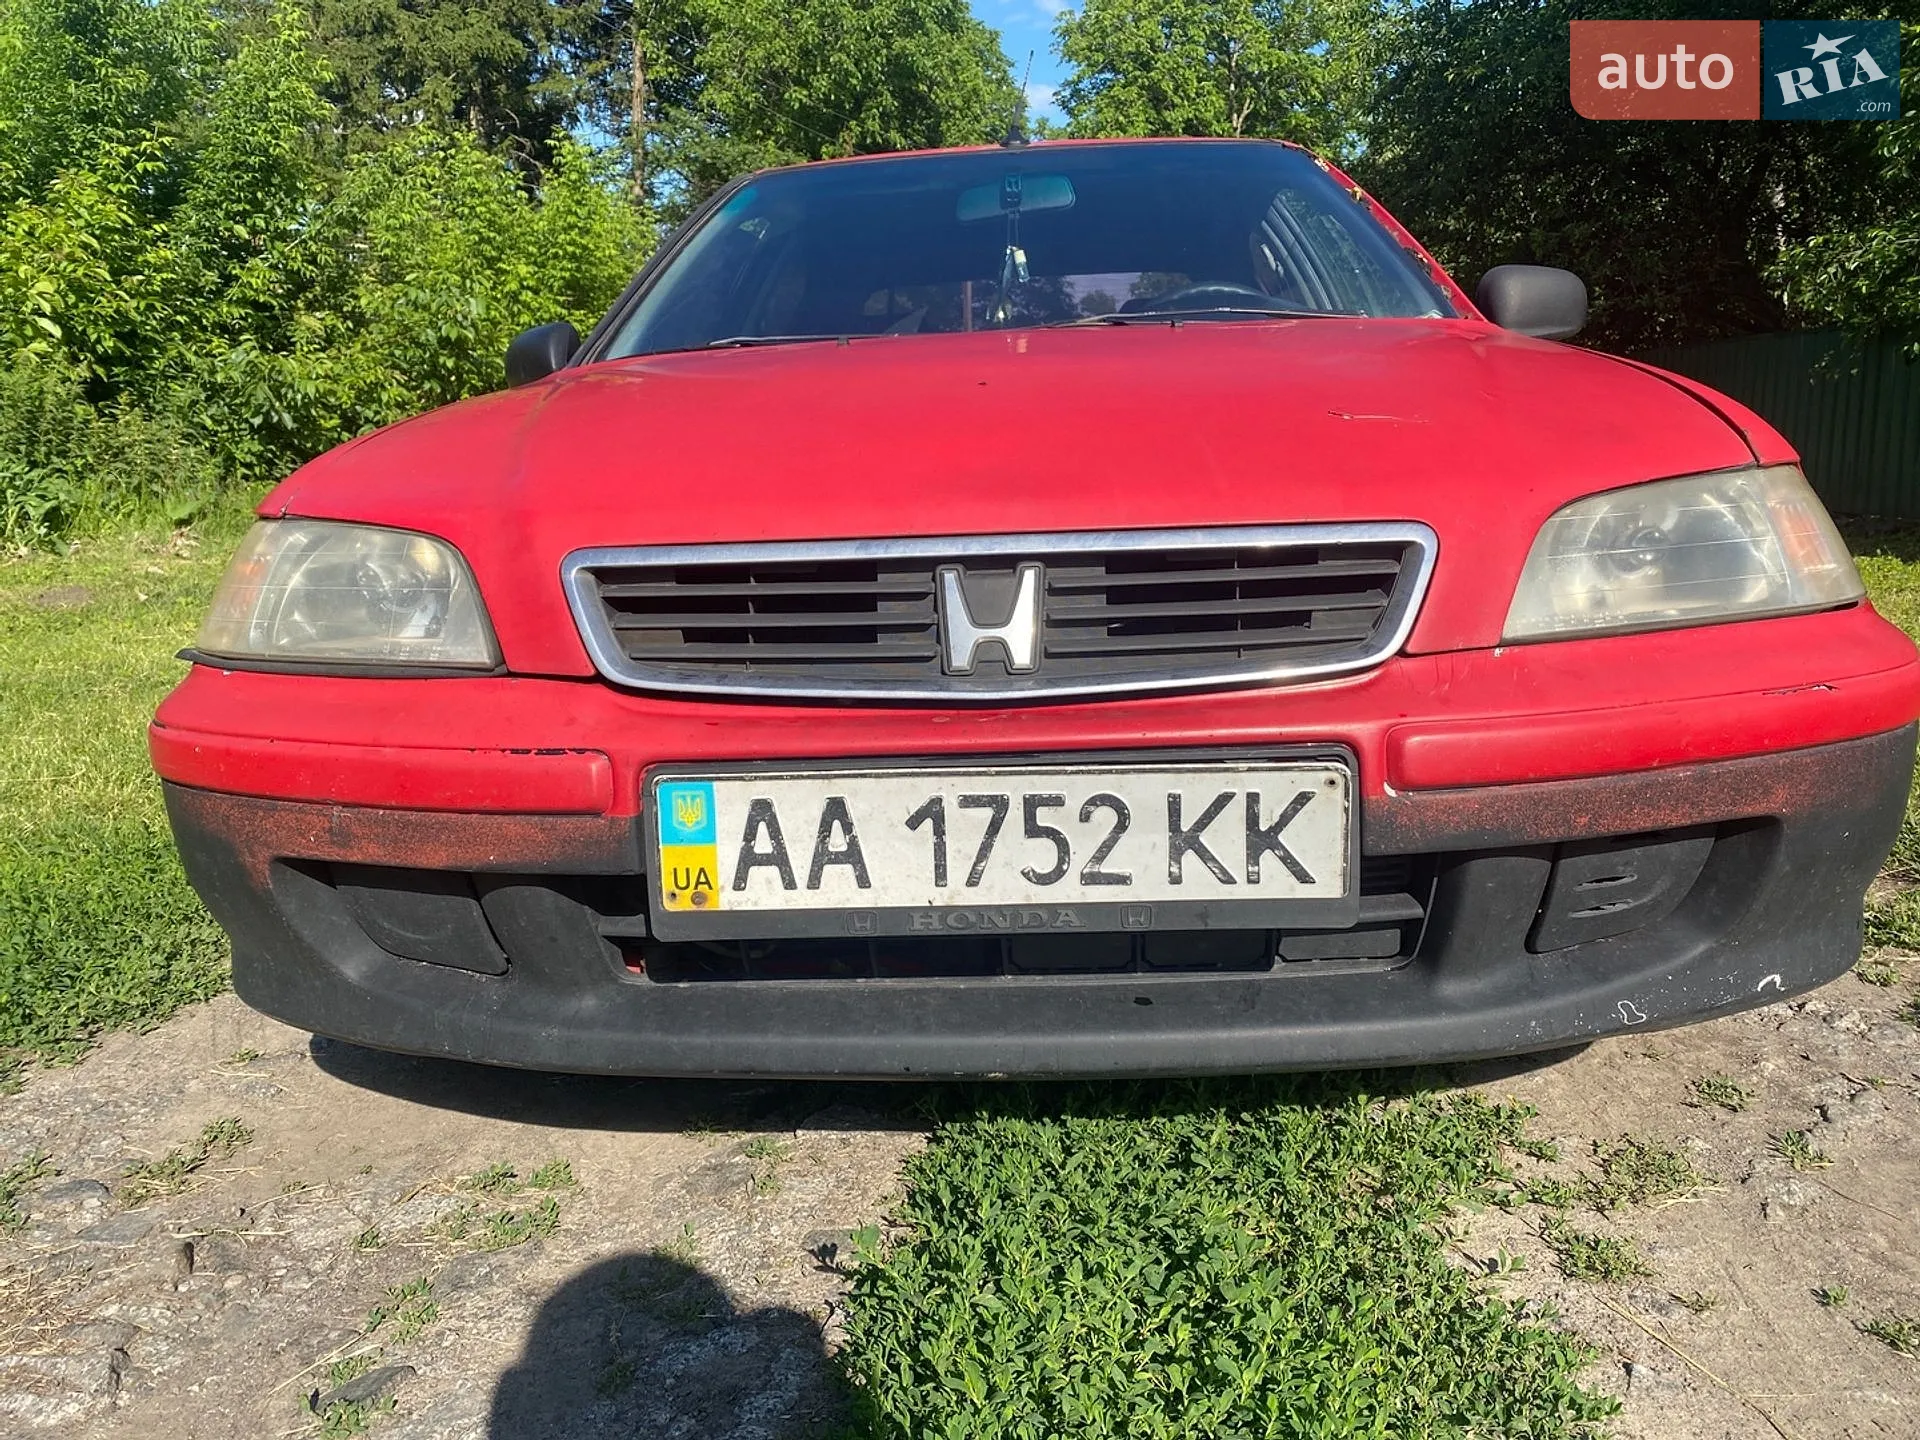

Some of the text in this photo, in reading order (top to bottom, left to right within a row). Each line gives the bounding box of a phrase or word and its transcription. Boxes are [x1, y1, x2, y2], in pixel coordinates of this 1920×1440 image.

[732, 790, 1317, 891] AA 1752 KK
[672, 866, 714, 891] UA
[908, 908, 1087, 932] HONDA
